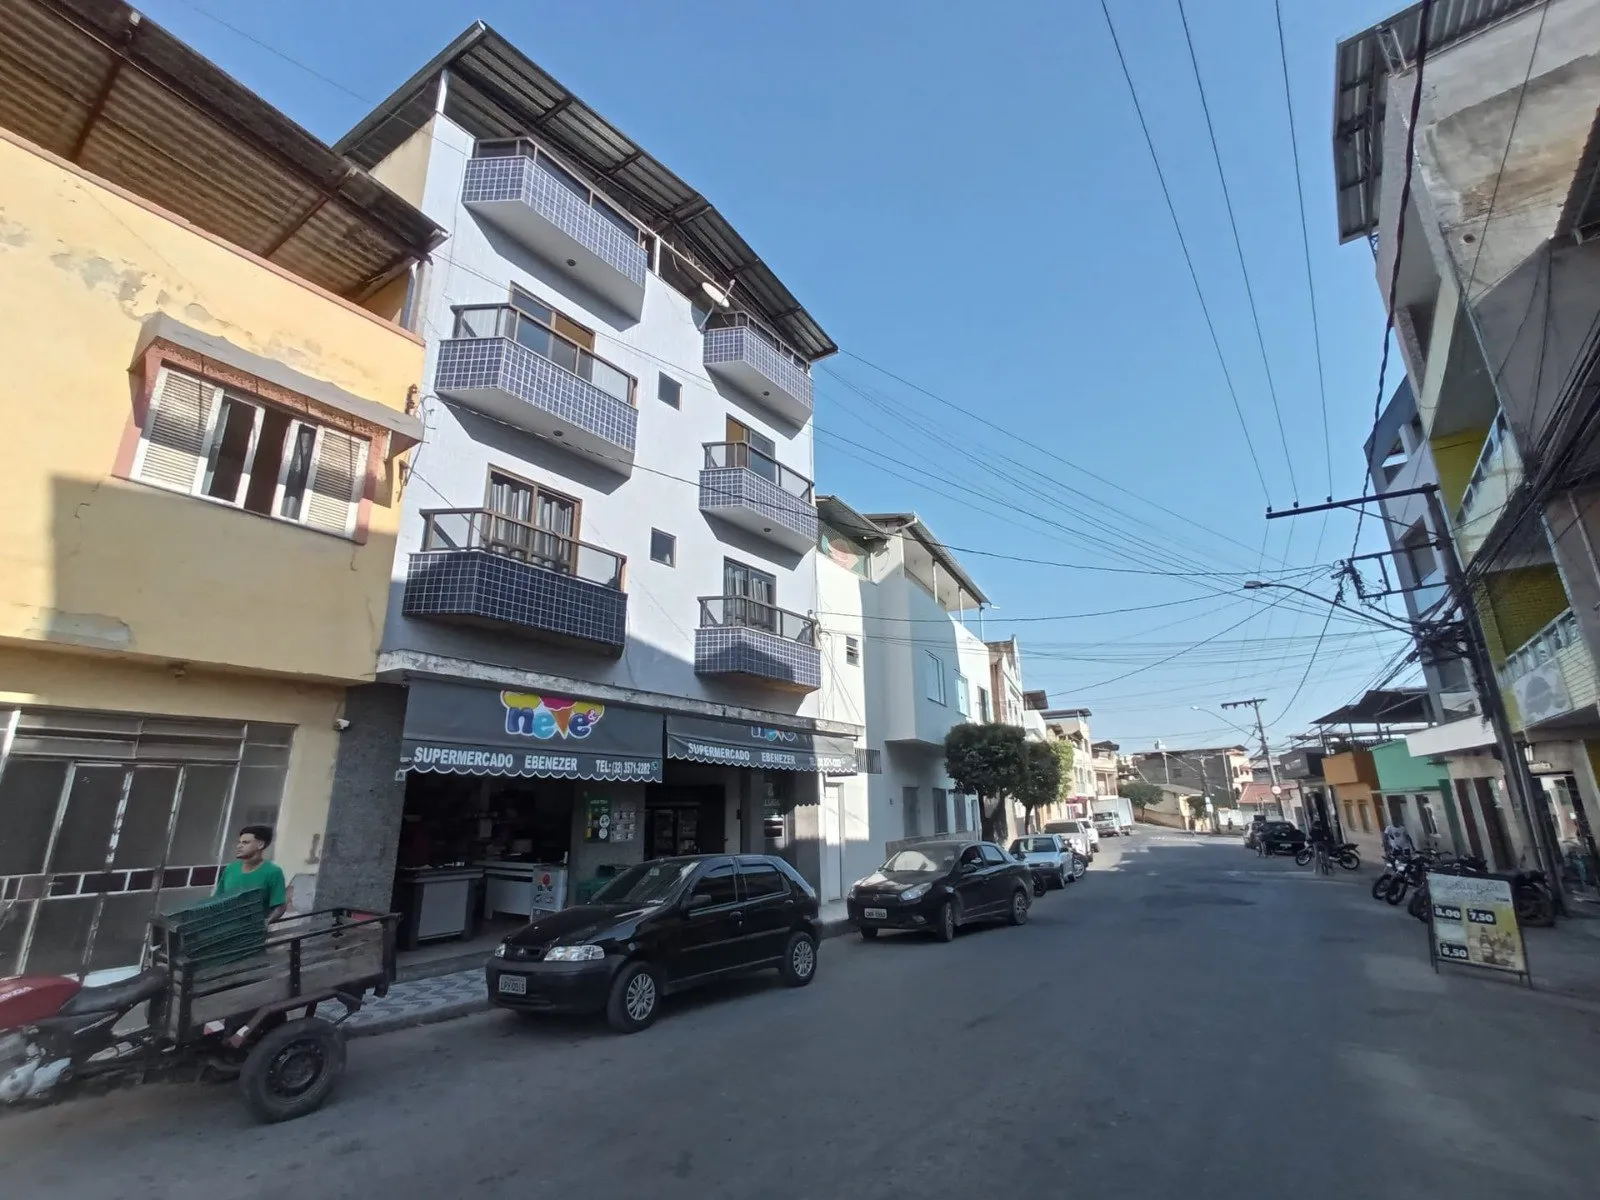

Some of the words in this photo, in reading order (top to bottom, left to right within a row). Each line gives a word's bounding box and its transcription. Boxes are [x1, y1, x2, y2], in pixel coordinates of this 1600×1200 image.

[414, 746, 514, 768] SUPERMERCADO
[524, 755, 578, 771] EBENEZER
[595, 759, 611, 773] TEL:
[688, 742, 751, 762] SUPERMERCADO
[761, 752, 796, 766] EBENEZER
